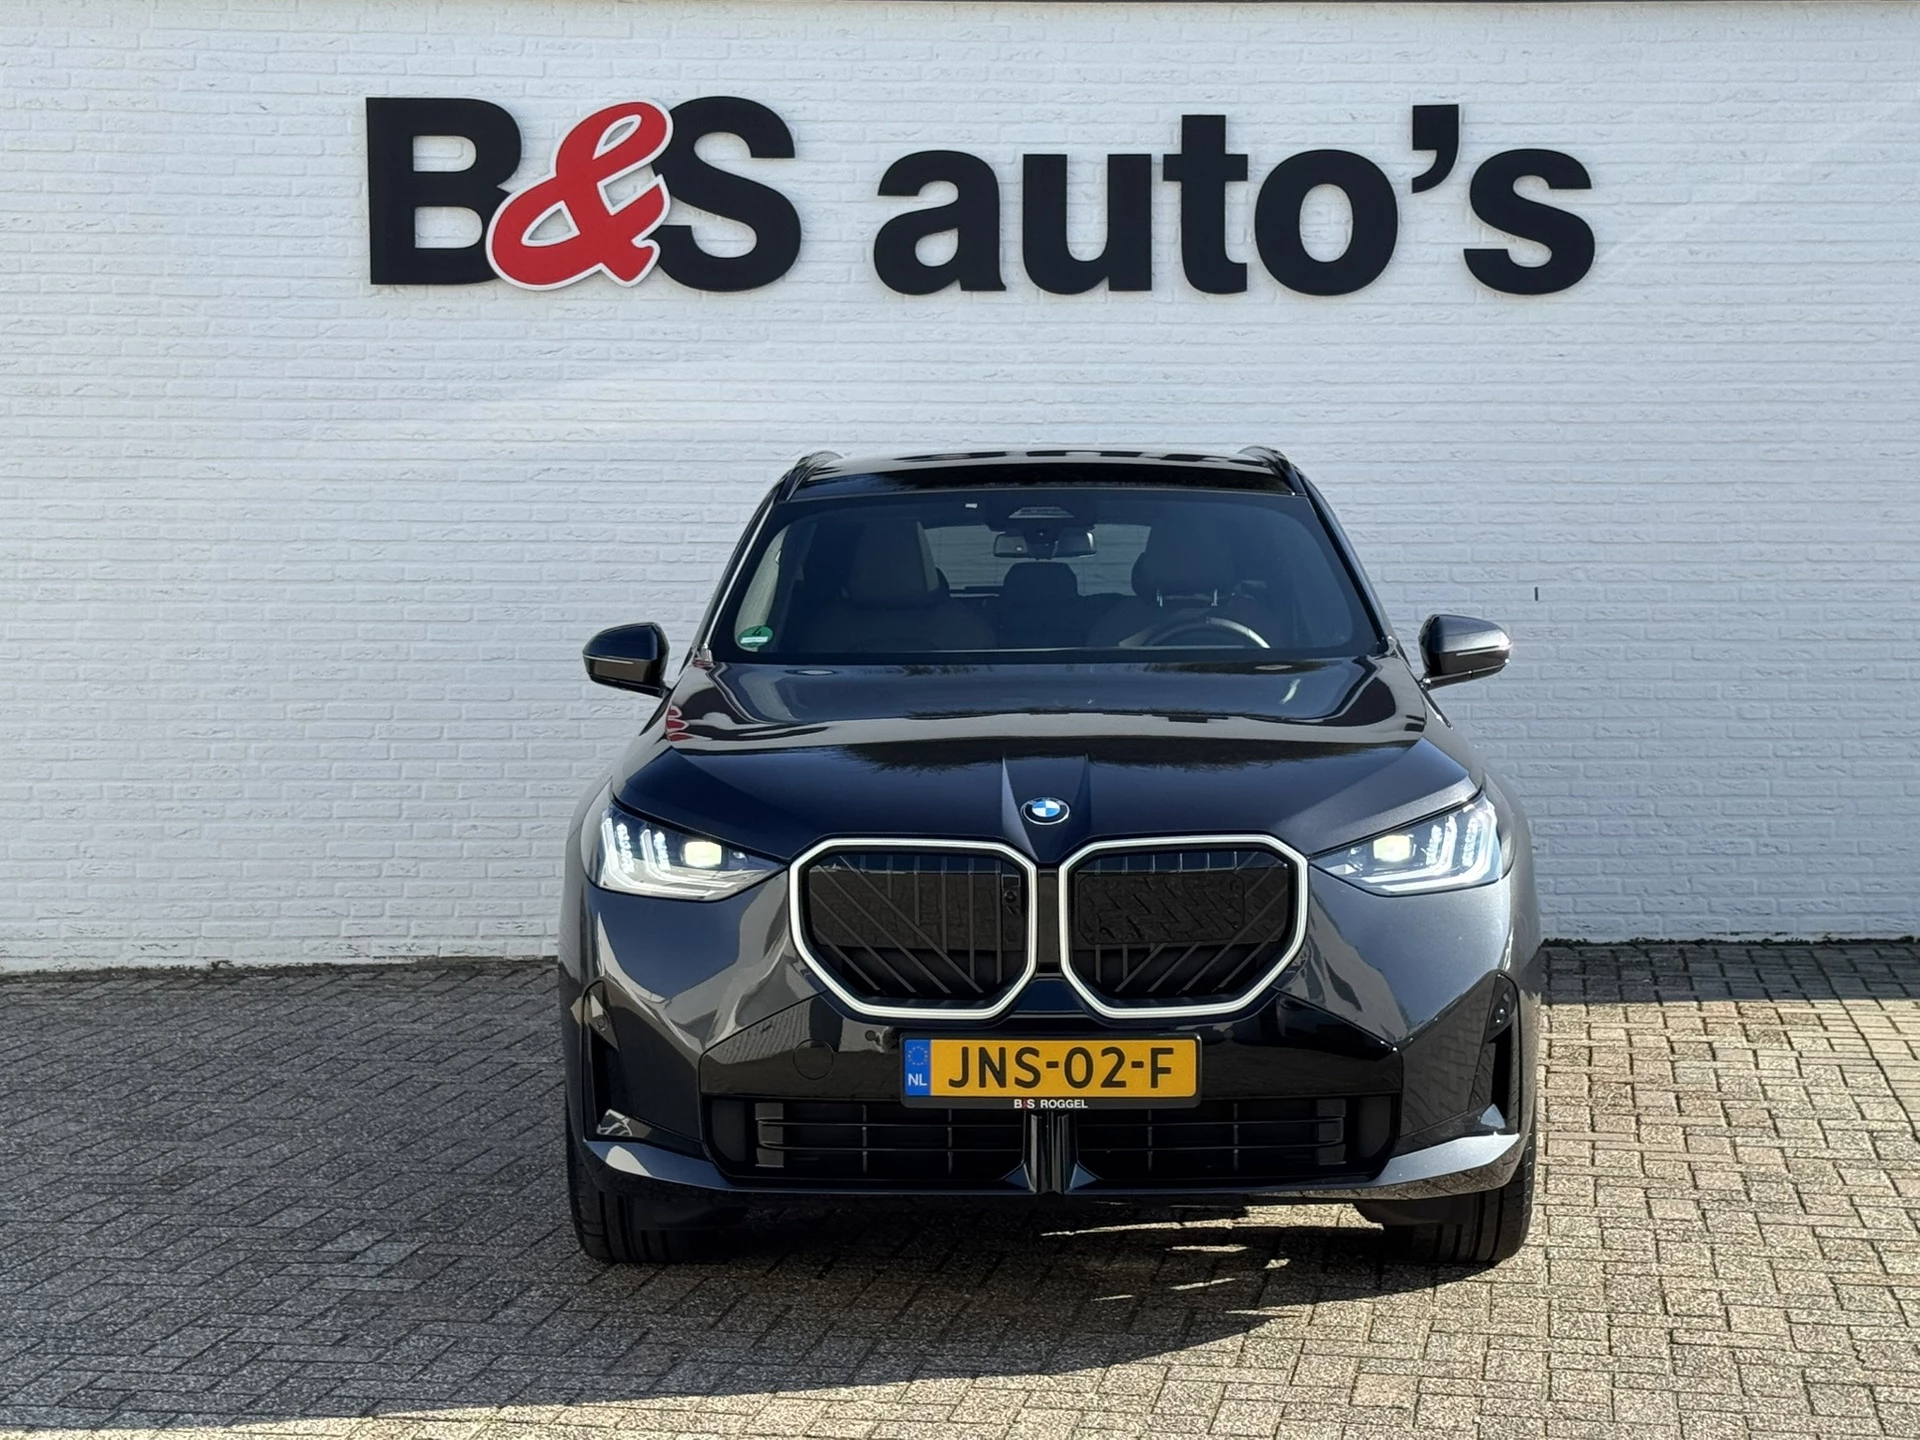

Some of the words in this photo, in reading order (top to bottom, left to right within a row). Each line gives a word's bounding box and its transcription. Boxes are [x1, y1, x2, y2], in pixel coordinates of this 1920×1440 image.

[366, 96, 802, 293] B&S
[874, 105, 1597, 297] auto's
[908, 1073, 928, 1087] NL
[948, 1046, 1174, 1089] JNS-02-F
[1040, 1099, 1089, 1109] ROGGEL
